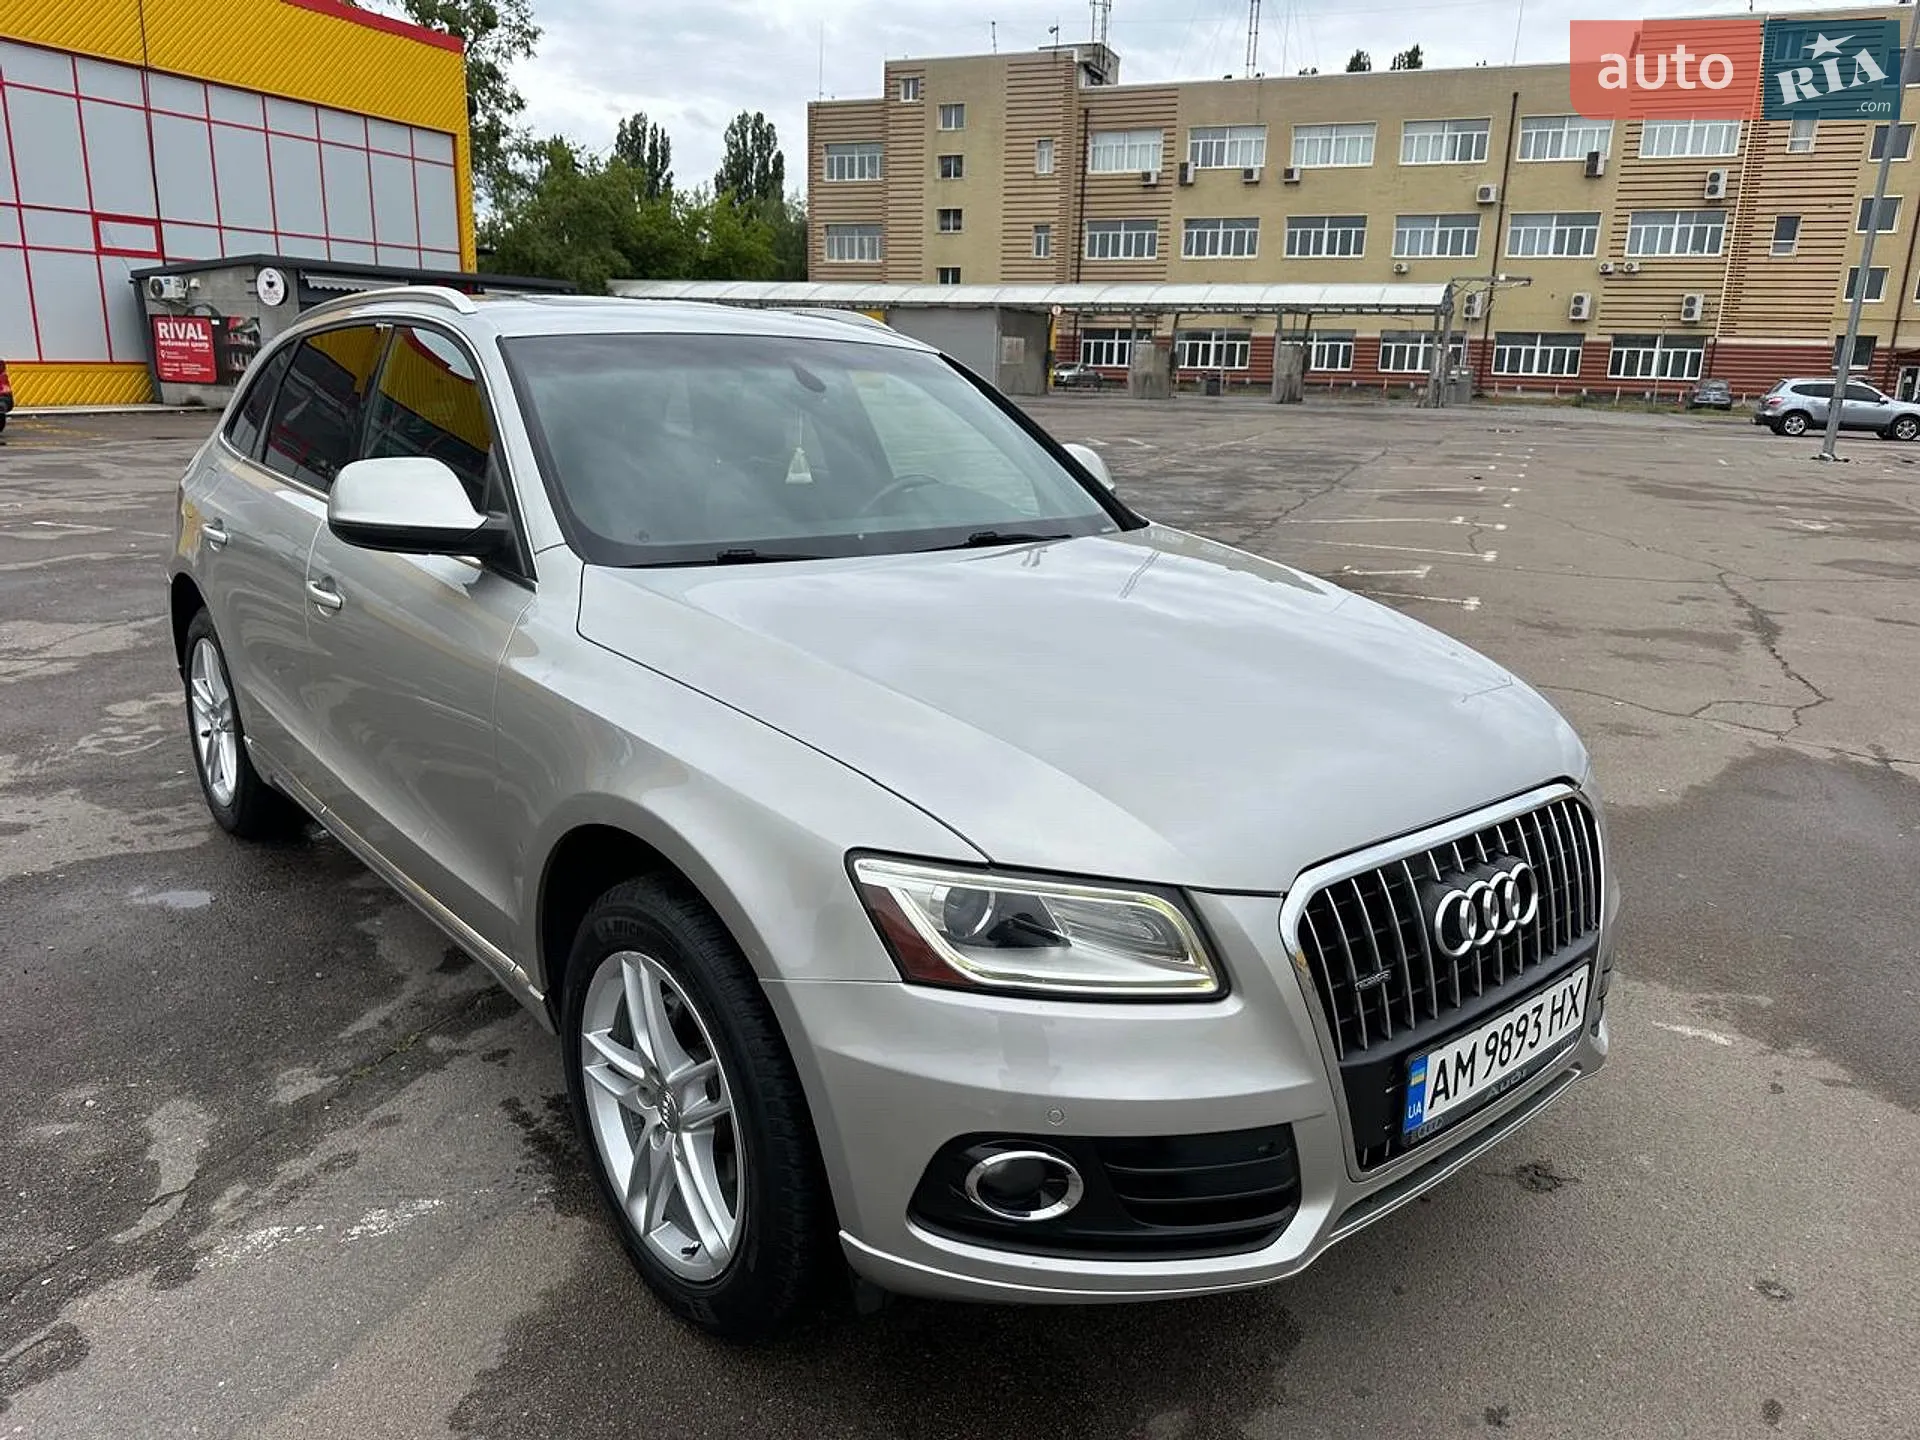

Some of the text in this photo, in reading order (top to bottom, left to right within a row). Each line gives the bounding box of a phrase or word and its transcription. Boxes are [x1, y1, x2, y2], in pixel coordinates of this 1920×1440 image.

[157, 322, 208, 340] RIVAL
[1428, 976, 1585, 1110] AM 9893 HX
[1407, 1101, 1422, 1119] UA
